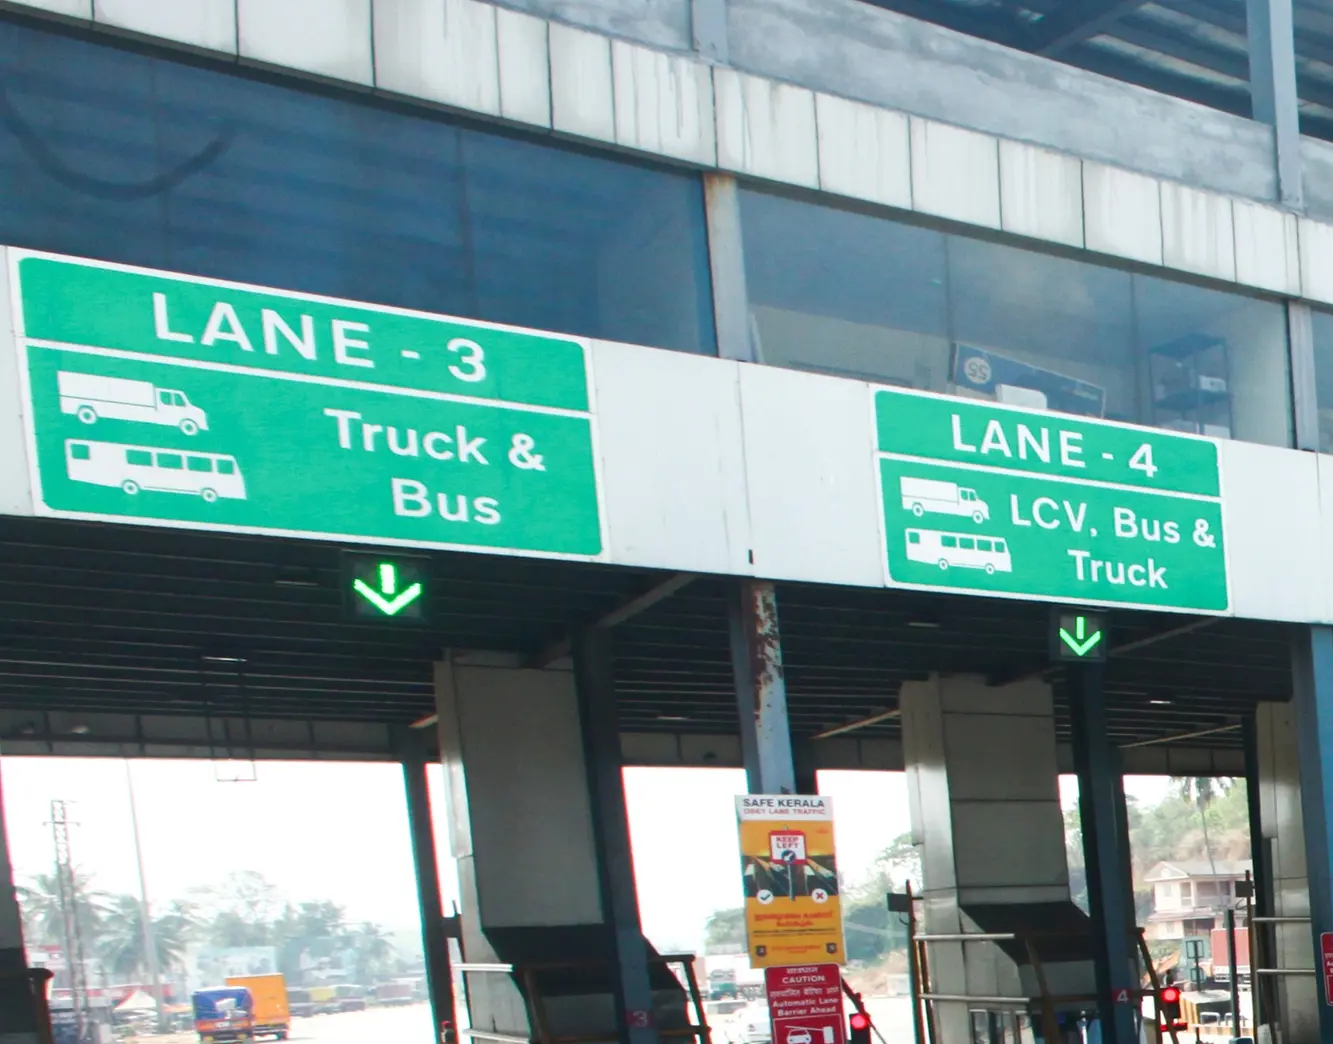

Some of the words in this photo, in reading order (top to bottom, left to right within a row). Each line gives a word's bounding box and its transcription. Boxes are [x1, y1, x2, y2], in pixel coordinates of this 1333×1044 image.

[152, 292, 376, 370] LANE
[400, 349, 420, 360] -
[446, 337, 487, 383] 3
[323, 407, 489, 466] Truck
[507, 432, 546, 471] &
[951, 413, 1086, 468] LANE
[1101, 452, 1114, 460] -
[1128, 442, 1158, 478] 4
[391, 477, 501, 525] Bus
[1010, 493, 1098, 537] LCV,
[1113, 506, 1181, 544] Bus
[1192, 518, 1217, 549] &
[1067, 549, 1168, 589] Truck
[743, 798, 774, 807] SAFE
[778, 799, 825, 808] KERALA
[781, 975, 825, 984] CAUTION
[772, 998, 816, 1008] Automatic
[819, 997, 839, 1005] Lane
[777, 1008, 807, 1017] Barrier
[810, 1005, 836, 1014] Ahead
[1117, 989, 1129, 1004] 4
[633, 1010, 648, 1028] 3
